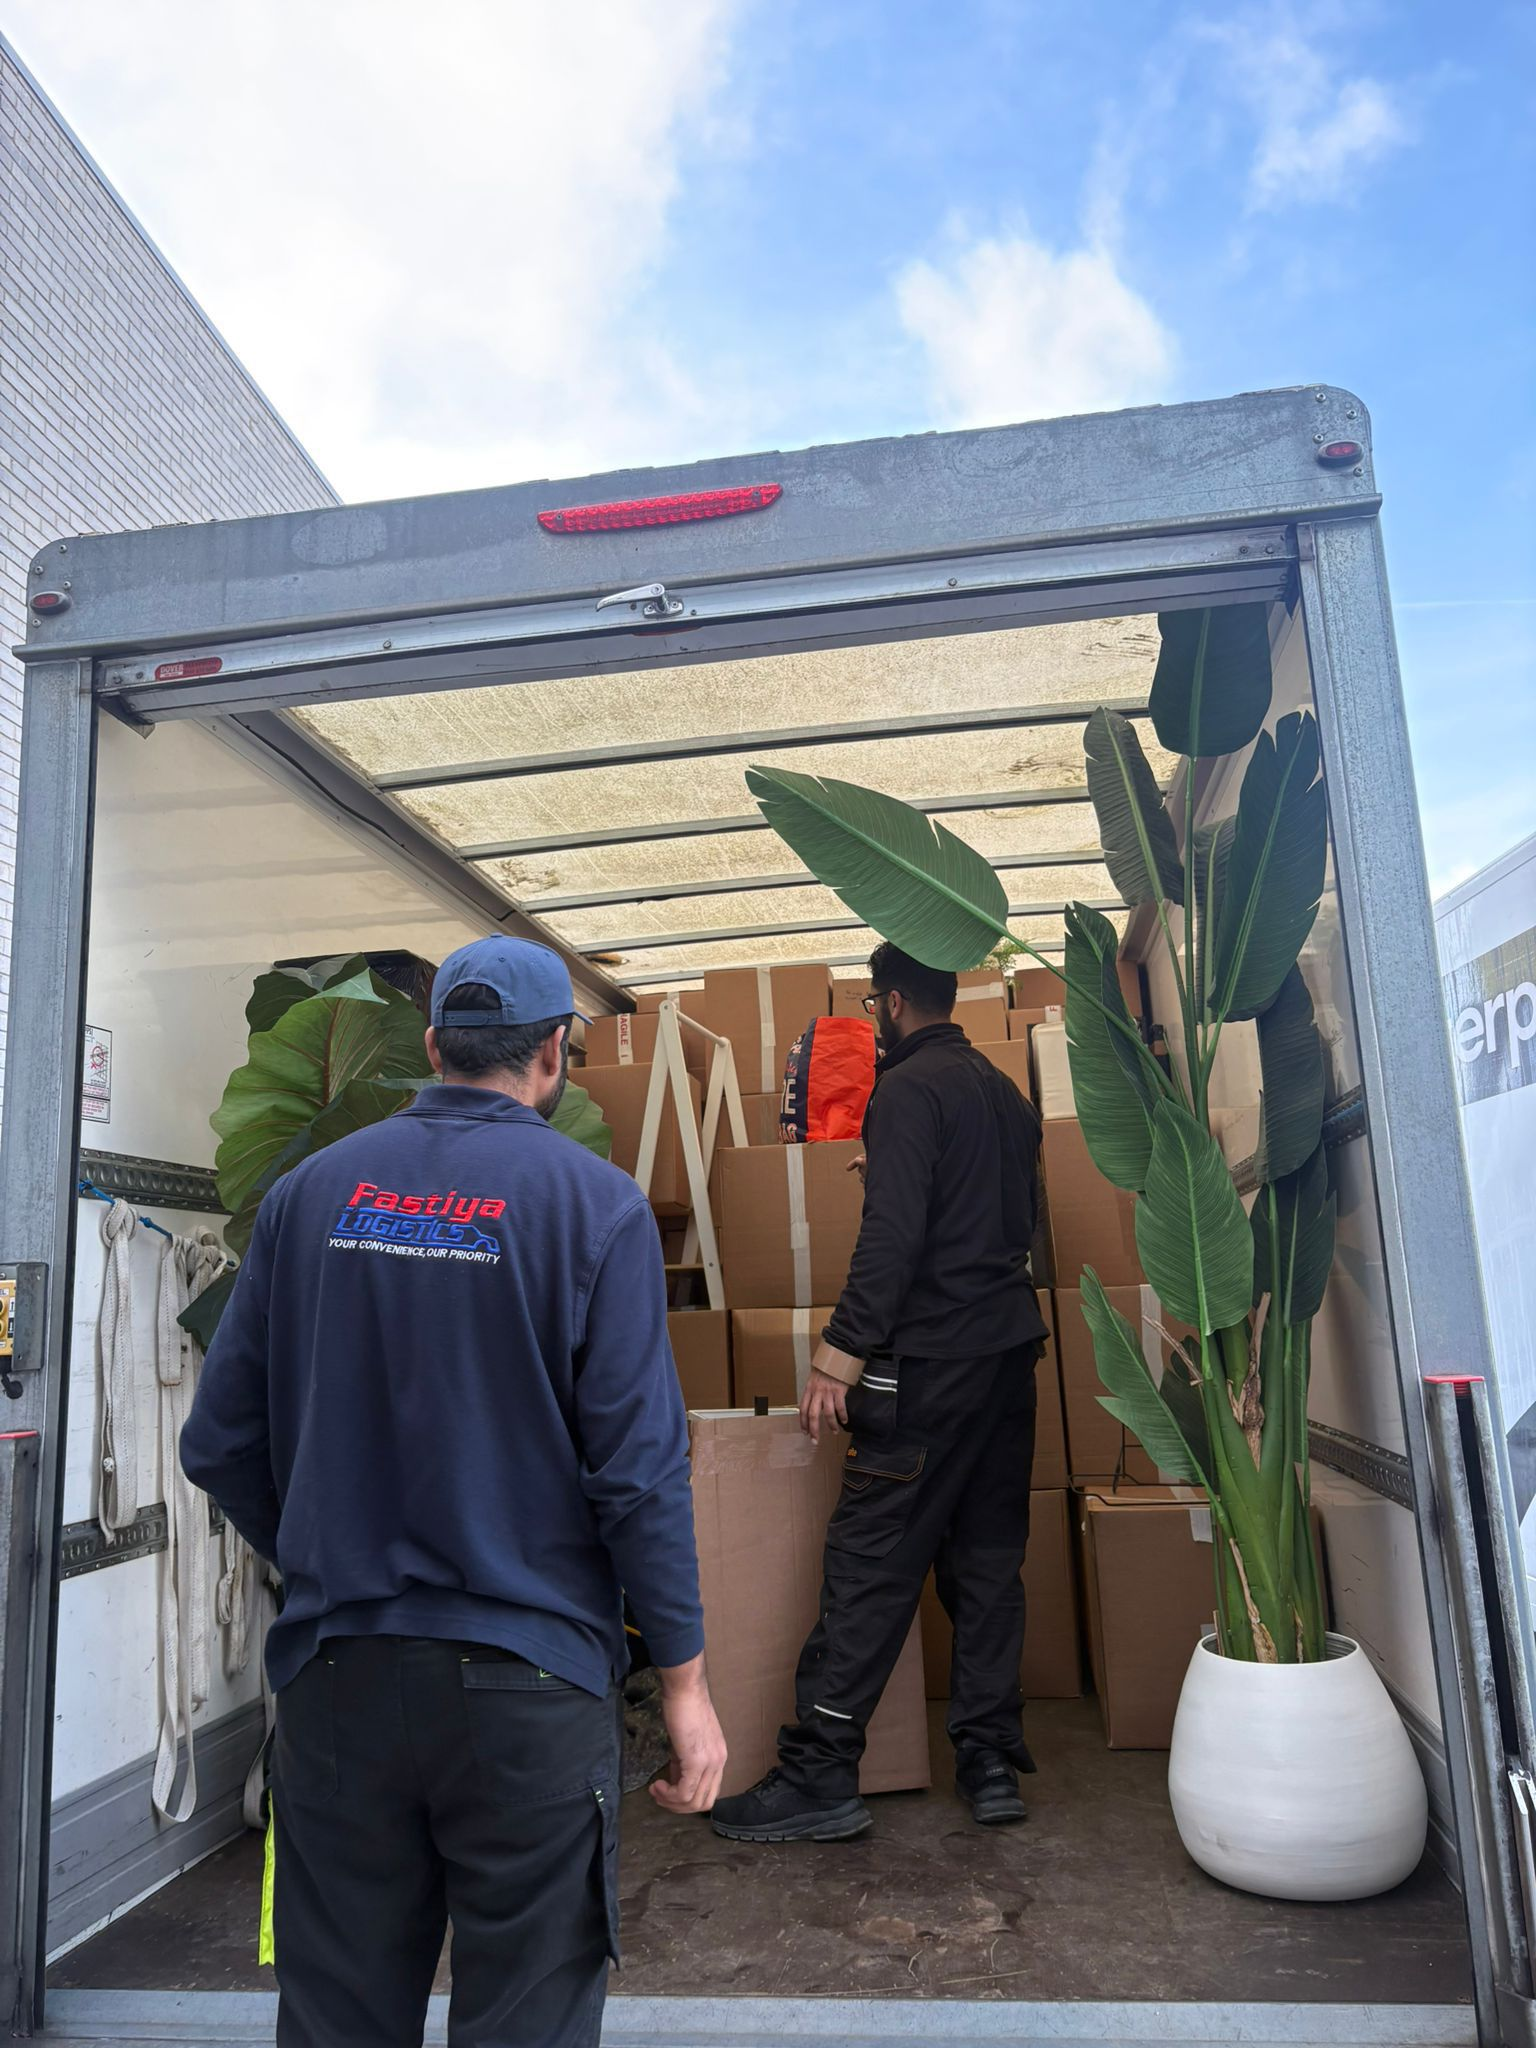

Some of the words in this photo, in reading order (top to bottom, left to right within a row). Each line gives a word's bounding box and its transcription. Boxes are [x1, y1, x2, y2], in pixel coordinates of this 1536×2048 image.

[347, 1182, 506, 1223] Fastiya
[335, 1213, 465, 1242] LOGISTICS
[328, 1238, 357, 1249] YOUR
[448, 1249, 501, 1265] PRIORITY
